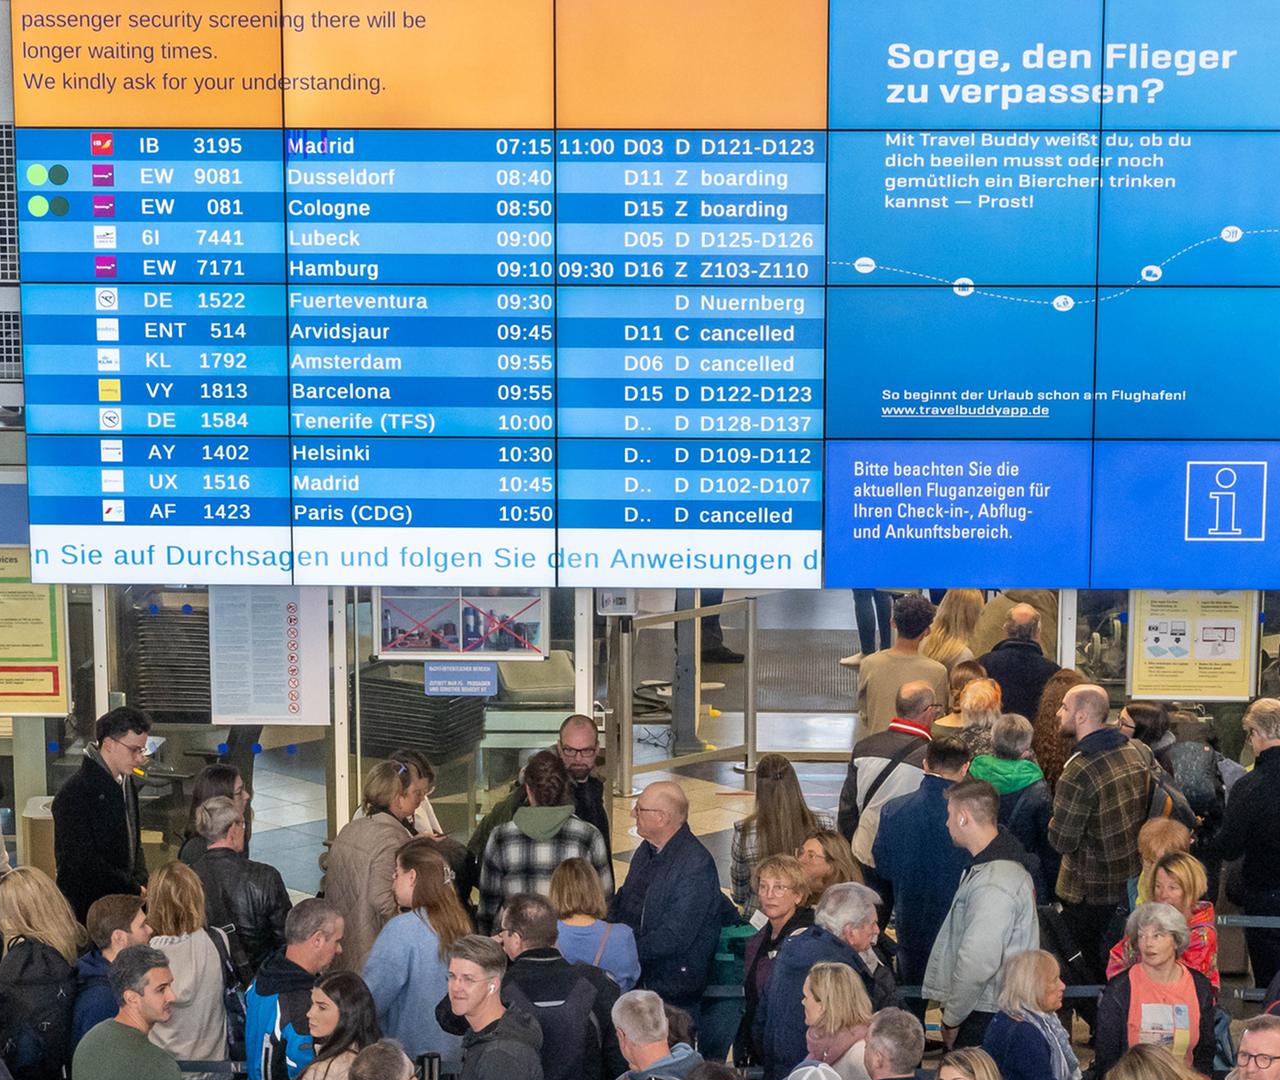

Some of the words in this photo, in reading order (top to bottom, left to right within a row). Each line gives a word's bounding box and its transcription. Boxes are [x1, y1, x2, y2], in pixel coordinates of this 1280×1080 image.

[22, 14, 122, 32] passenger
[129, 13, 202, 32] security
[209, 11, 304, 33] screening
[312, 11, 360, 28] there
[367, 11, 395, 27] will
[404, 11, 425, 28] be
[23, 42, 81, 63] longer
[88, 44, 153, 63] waiting
[161, 44, 216, 59] times.
[888, 44, 1010, 75] Sorge,
[1023, 43, 1091, 68] den
[1107, 43, 1237, 76] Flieger
[24, 74, 55, 89] We
[63, 73, 116, 94] kindly
[123, 73, 156, 89] ask
[163, 73, 187, 90] for
[194, 77, 235, 94] your
[242, 73, 385, 94] understanding.
[887, 84, 928, 103] zu
[940, 79, 1164, 109] verpassen?
[140, 138, 159, 153] IB
[194, 138, 242, 153] 3195
[289, 137, 354, 154] Madrid
[496, 139, 551, 154] 07:15
[560, 139, 614, 154] 11:00
[624, 139, 663, 155] D03
[676, 139, 690, 154] D
[702, 139, 814, 155] D121-D123
[886, 133, 914, 146] Mit
[920, 133, 975, 146] Travel
[982, 133, 1040, 149] Buddy
[1045, 133, 1098, 146] weißt
[1106, 133, 1133, 148] du,
[1140, 133, 1162, 146] ob
[1168, 134, 1191, 147] du
[885, 154, 924, 167] dich
[931, 154, 997, 167] beeilen
[1004, 155, 1062, 167] musst
[1068, 154, 1112, 167] oder
[1118, 154, 1163, 167] noch
[885, 174, 979, 191] gemütlich
[985, 174, 1012, 187] ein
[1019, 174, 1103, 187] Bierchen
[1110, 174, 1175, 187] trinken
[885, 195, 948, 208] kannst
[979, 195, 1033, 208] Prost!
[144, 260, 176, 275] EW
[197, 260, 244, 275] 7171
[290, 260, 378, 280] Hamburg
[497, 262, 552, 277] 09:10
[559, 262, 614, 278] 09:30
[625, 262, 663, 277] D16
[675, 262, 687, 277] Z
[701, 262, 808, 278] Z103-Z110
[882, 390, 899, 399] So
[904, 390, 957, 402] beginnt
[961, 390, 984, 400] der
[988, 390, 1033, 400] Urlaub
[1038, 390, 1079, 400] schon
[1084, 392, 1107, 400] am
[1112, 390, 1185, 402] Flughafen!
[882, 405, 1049, 417] www.travelbuddyapp.de
[148, 412, 175, 428] DE
[202, 413, 248, 428] 1584
[292, 413, 372, 428] Tenerife
[381, 413, 435, 432] (TFS)
[499, 415, 552, 430] 10:00
[625, 416, 650, 430] D..
[675, 416, 689, 430] D
[701, 416, 811, 431] D128-D137
[150, 504, 176, 518] AF
[204, 504, 250, 519] 1423
[295, 505, 343, 520] Paris
[352, 505, 412, 524] (CDG)
[500, 506, 552, 521] 10:50
[625, 507, 650, 522] D..
[675, 507, 688, 522] D
[700, 508, 792, 523] cancelled
[62, 544, 102, 564] Sie
[115, 545, 154, 565] auf
[167, 544, 328, 572] Durchsagen
[341, 547, 388, 566] und
[400, 547, 481, 572] folgen
[495, 548, 535, 568] Sie
[549, 548, 598, 568] den
[611, 549, 791, 574] Anweisungen
